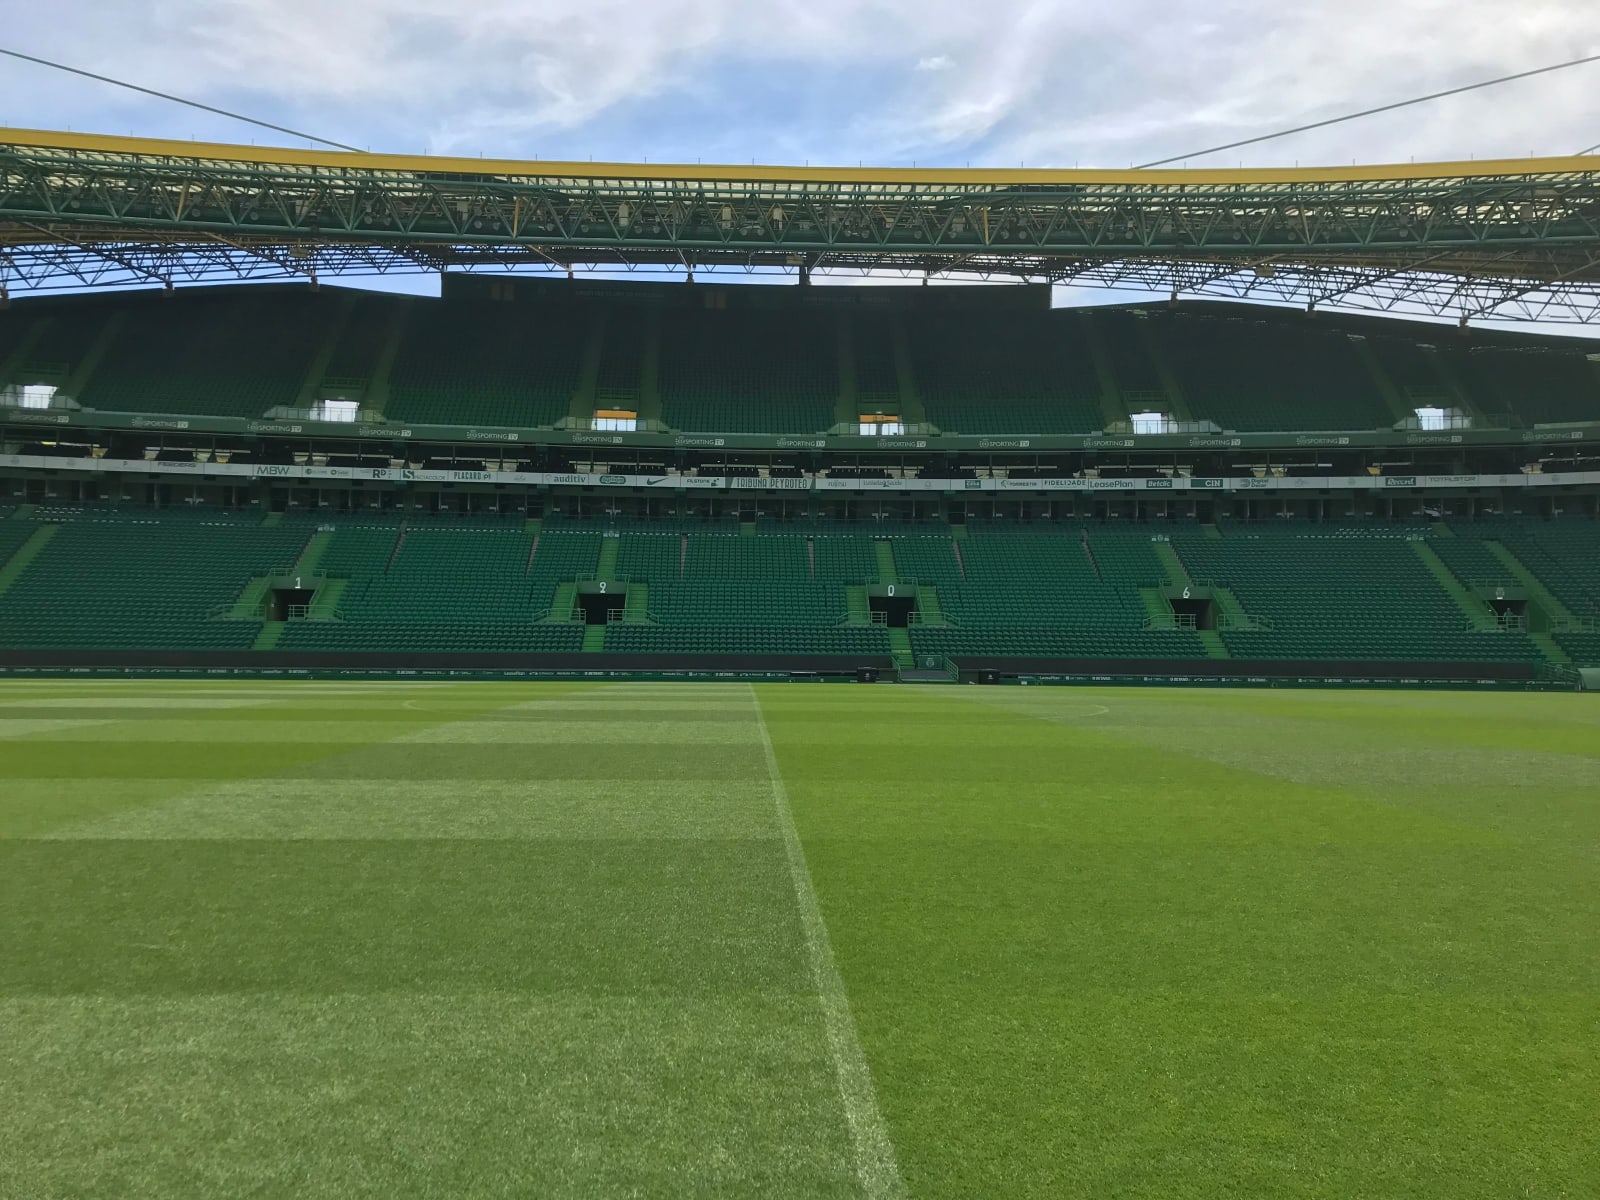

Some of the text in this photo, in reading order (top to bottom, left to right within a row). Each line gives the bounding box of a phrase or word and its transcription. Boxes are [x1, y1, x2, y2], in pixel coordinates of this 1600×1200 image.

[257, 466, 290, 475] MBW
[553, 475, 587, 484] auditiv
[737, 478, 807, 489] TRIBUNA PEYROTEO
[1090, 480, 1133, 488] LeasePlan
[294, 576, 301, 589] 1
[1182, 586, 1191, 599] 6
